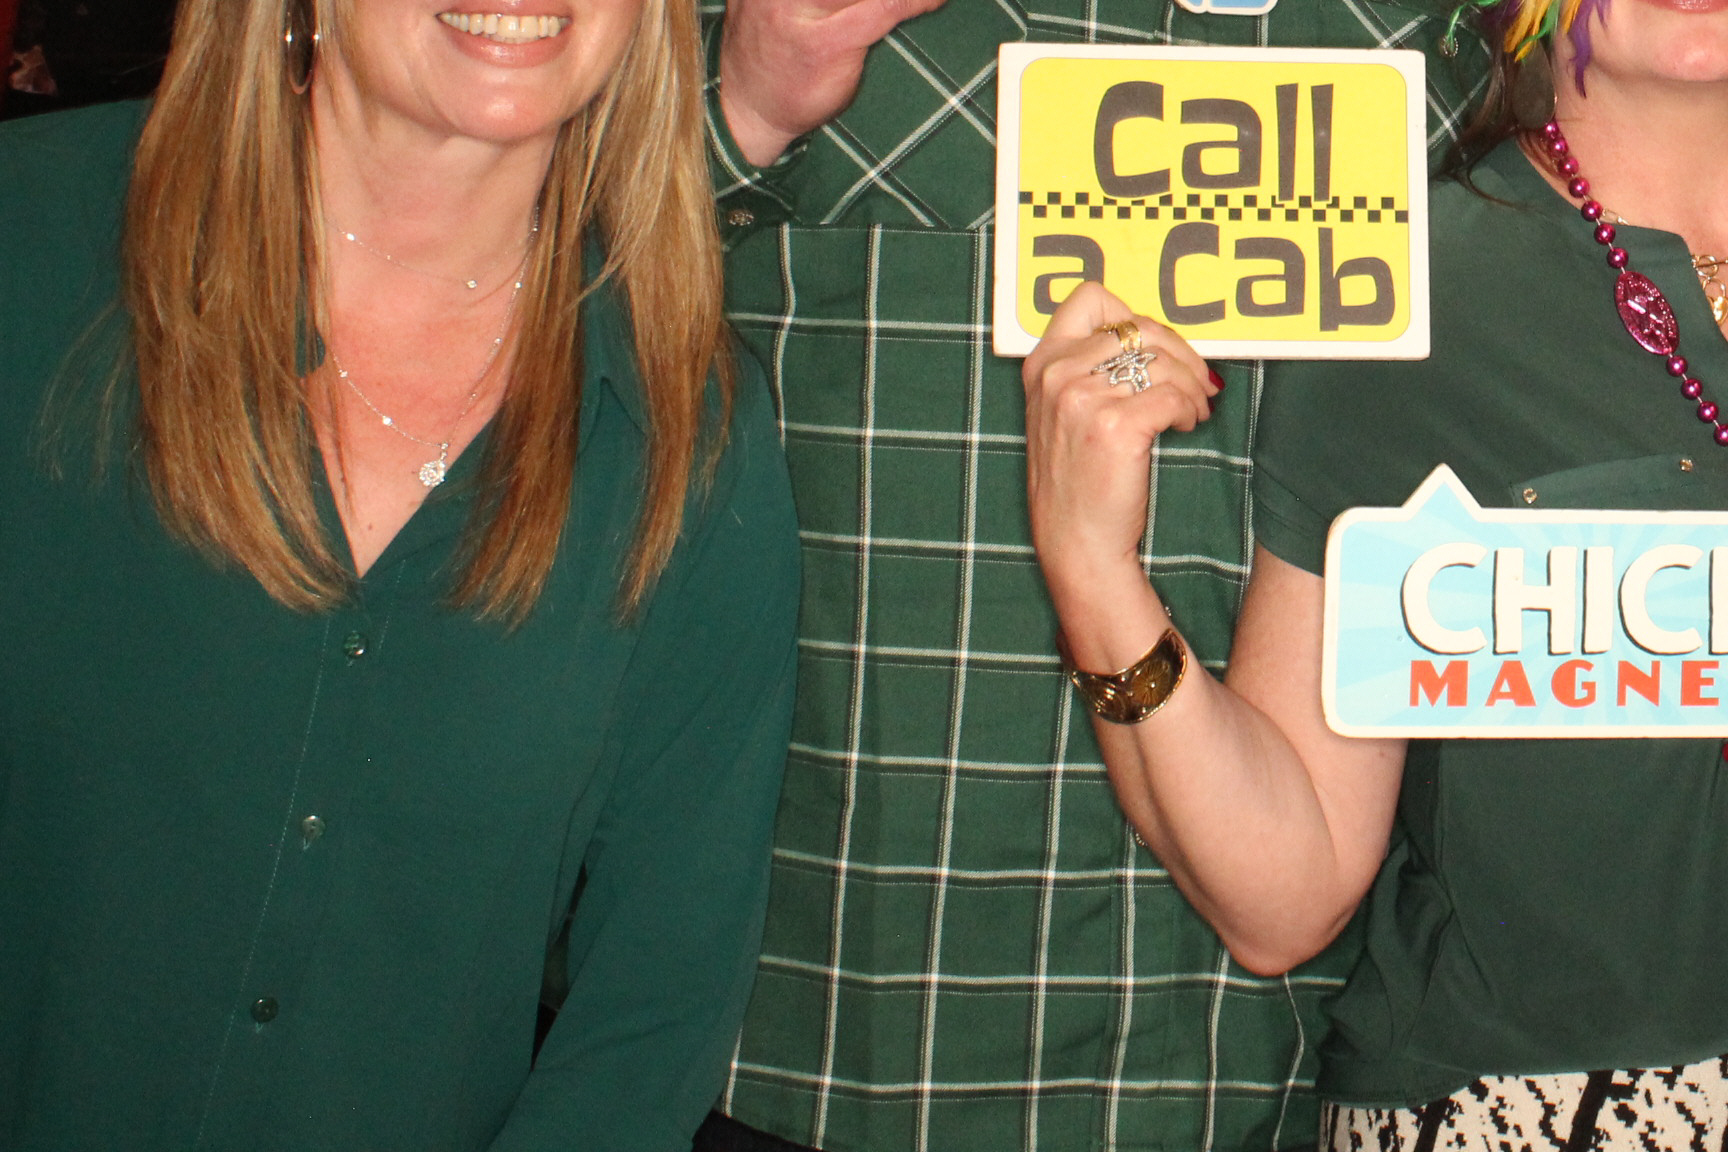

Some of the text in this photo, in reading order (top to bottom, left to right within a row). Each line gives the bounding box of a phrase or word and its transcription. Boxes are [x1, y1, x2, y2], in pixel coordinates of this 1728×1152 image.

[1094, 81, 1334, 202] Call
[1033, 222, 1396, 332] a Cab
